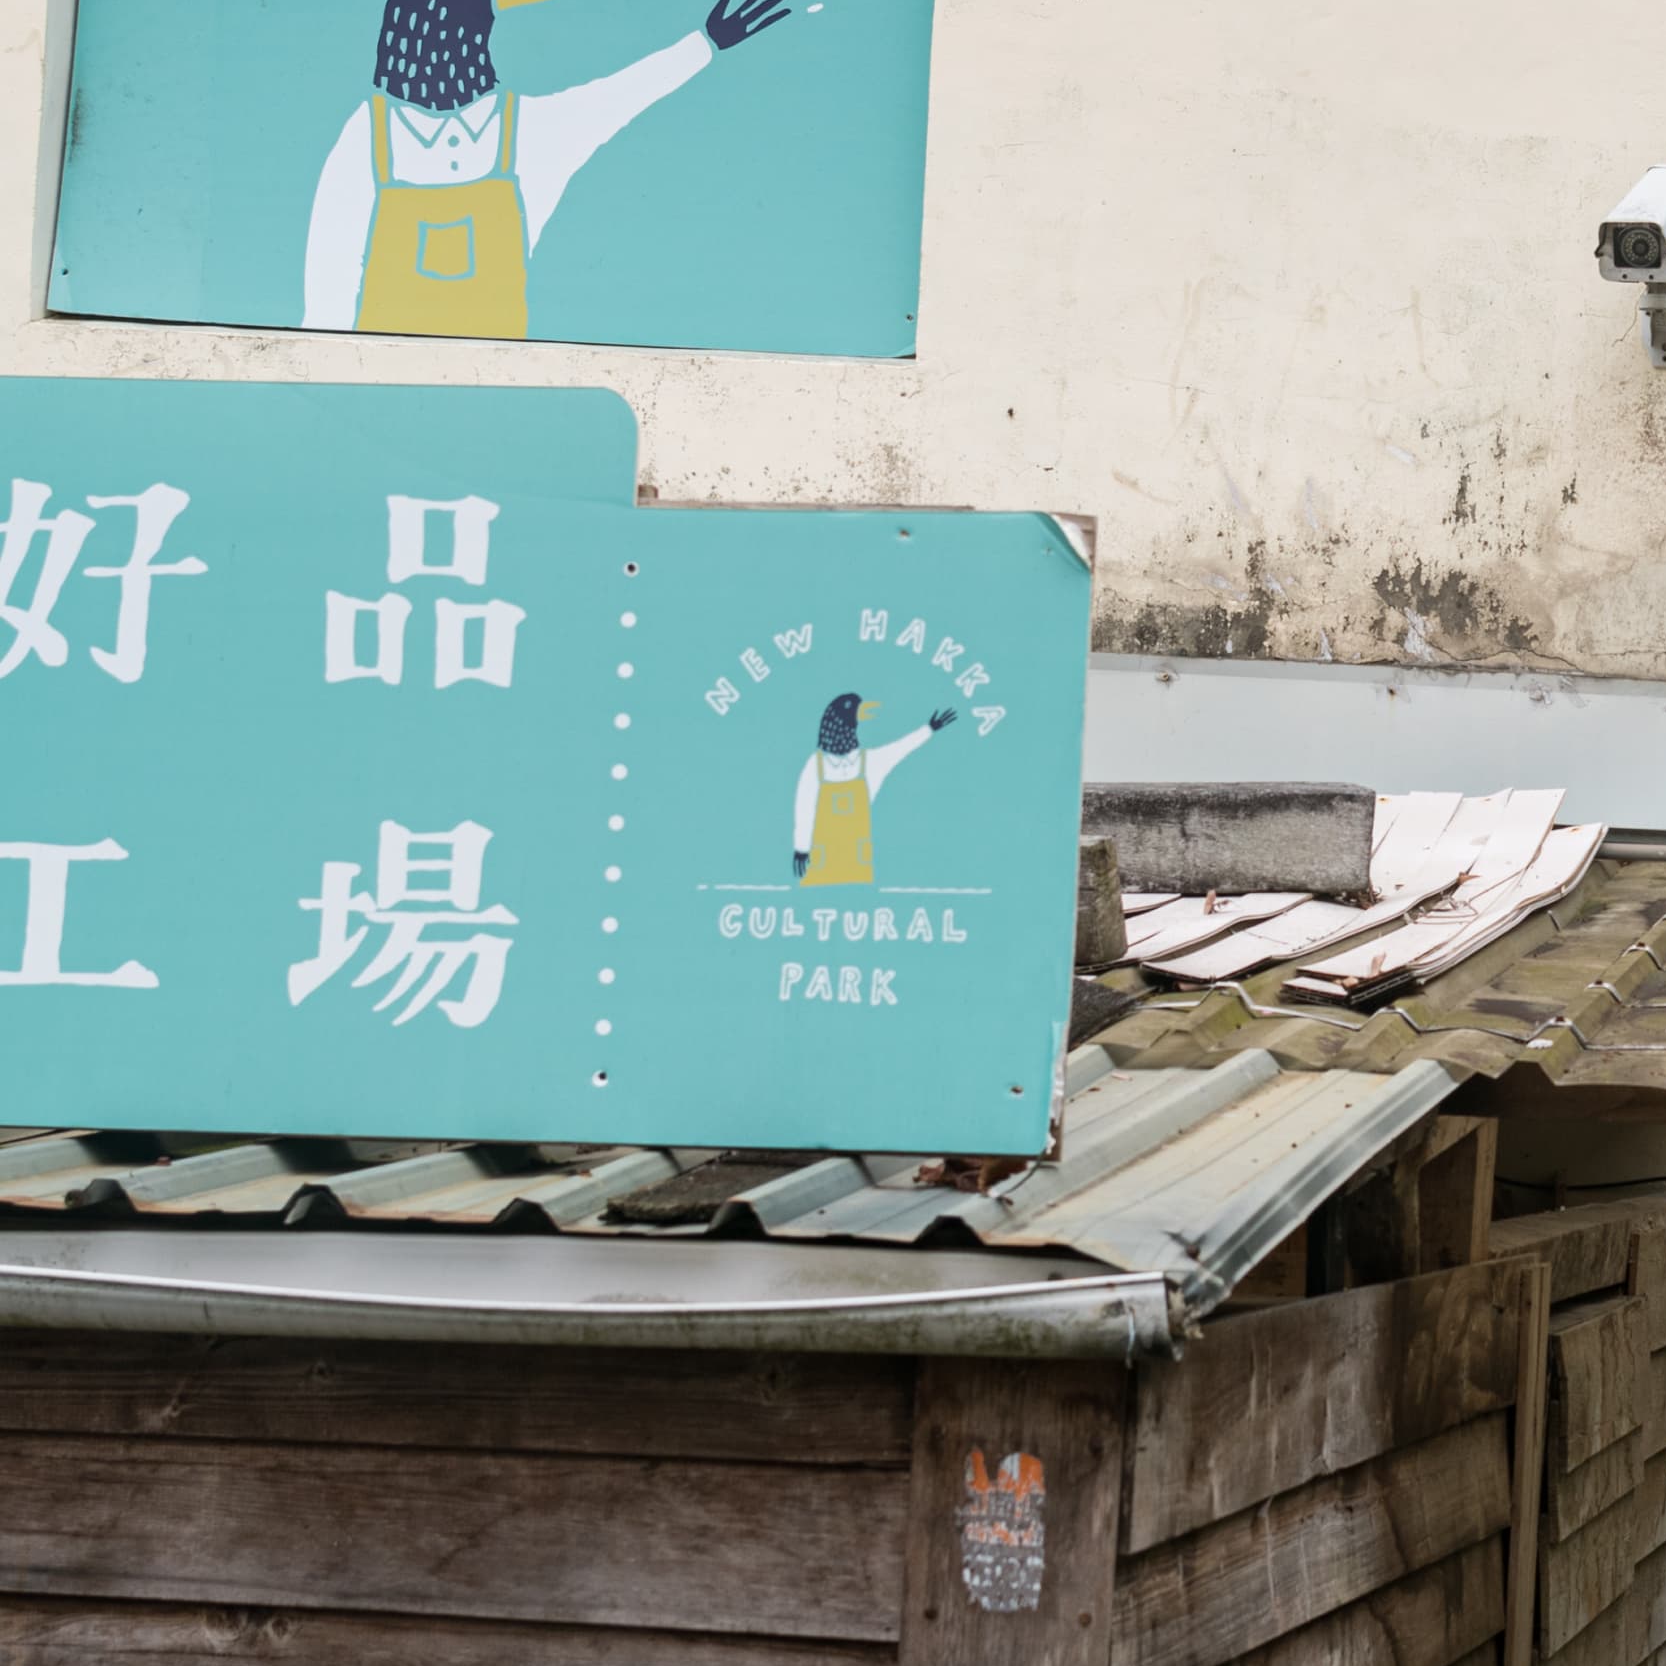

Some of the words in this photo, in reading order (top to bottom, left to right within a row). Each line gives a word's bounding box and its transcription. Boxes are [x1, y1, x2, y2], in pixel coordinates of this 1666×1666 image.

[704, 623, 813, 716] NEW
[858, 608, 1006, 737] HAKKA
[719, 903, 967, 943] CULTURAL
[779, 962, 898, 1006] PARK
